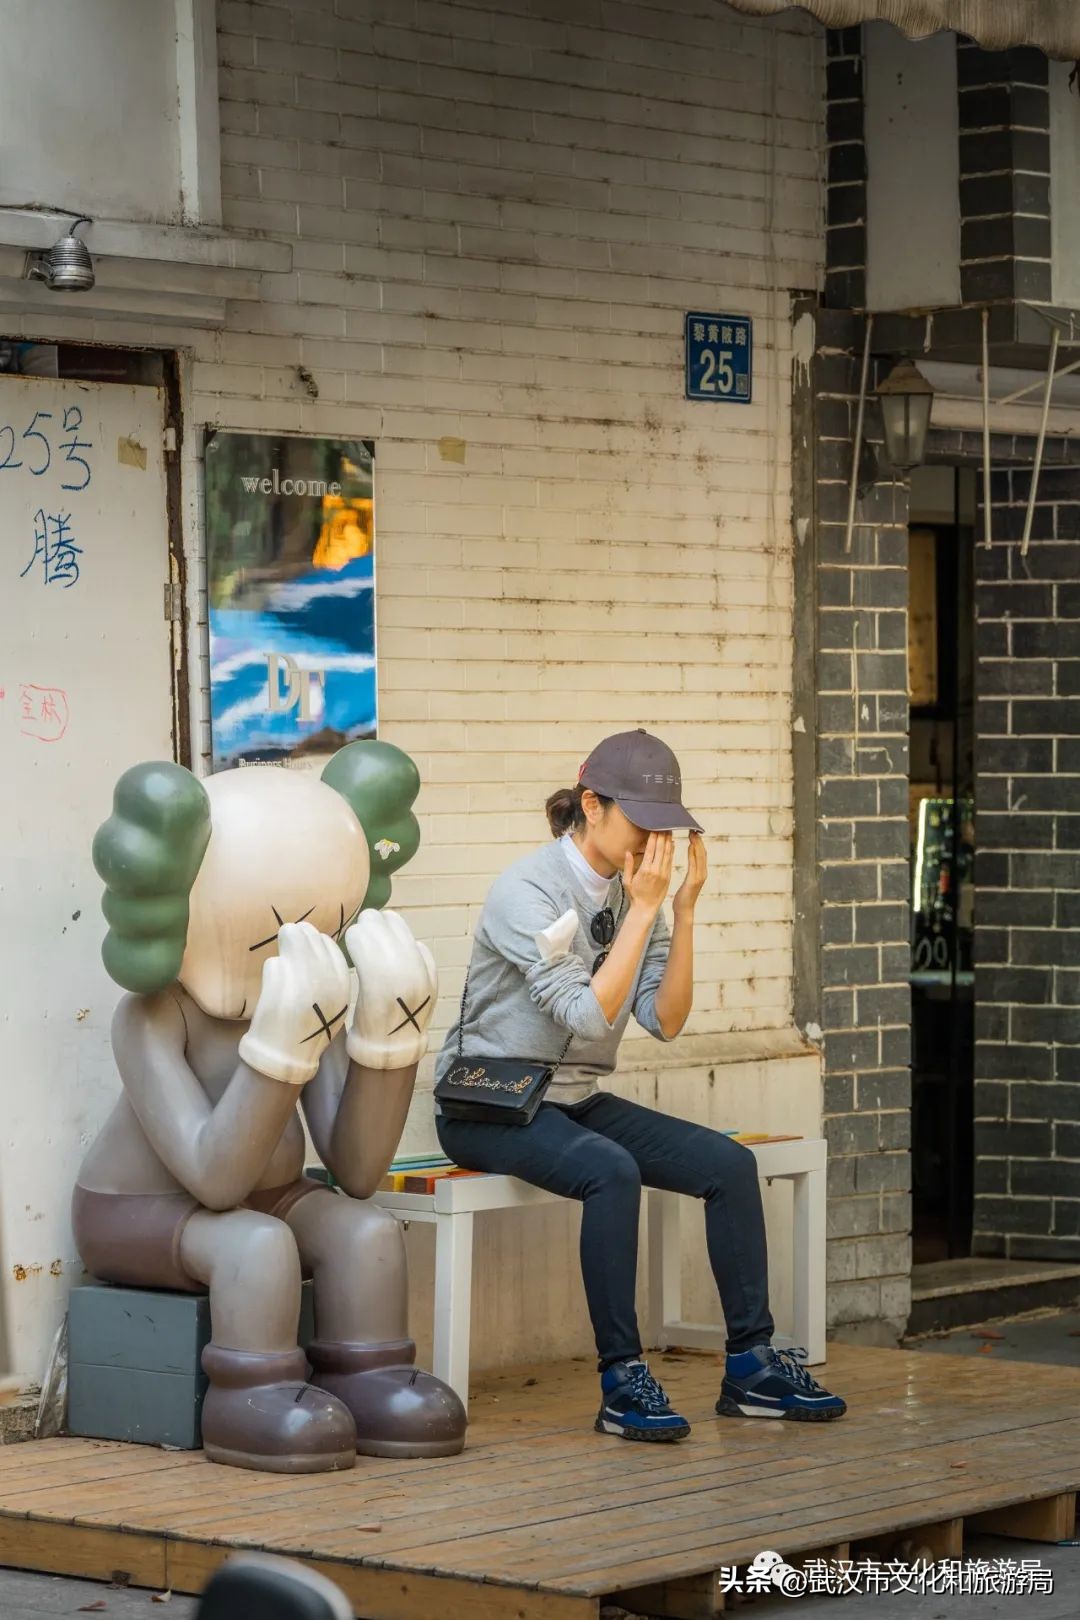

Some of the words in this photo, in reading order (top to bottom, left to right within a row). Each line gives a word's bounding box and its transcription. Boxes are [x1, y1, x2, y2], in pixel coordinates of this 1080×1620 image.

[700, 348, 733, 393] 25
[0, 406, 92, 491] 25号
[240, 468, 342, 497] welcome
[642, 774, 681, 785] TESL
